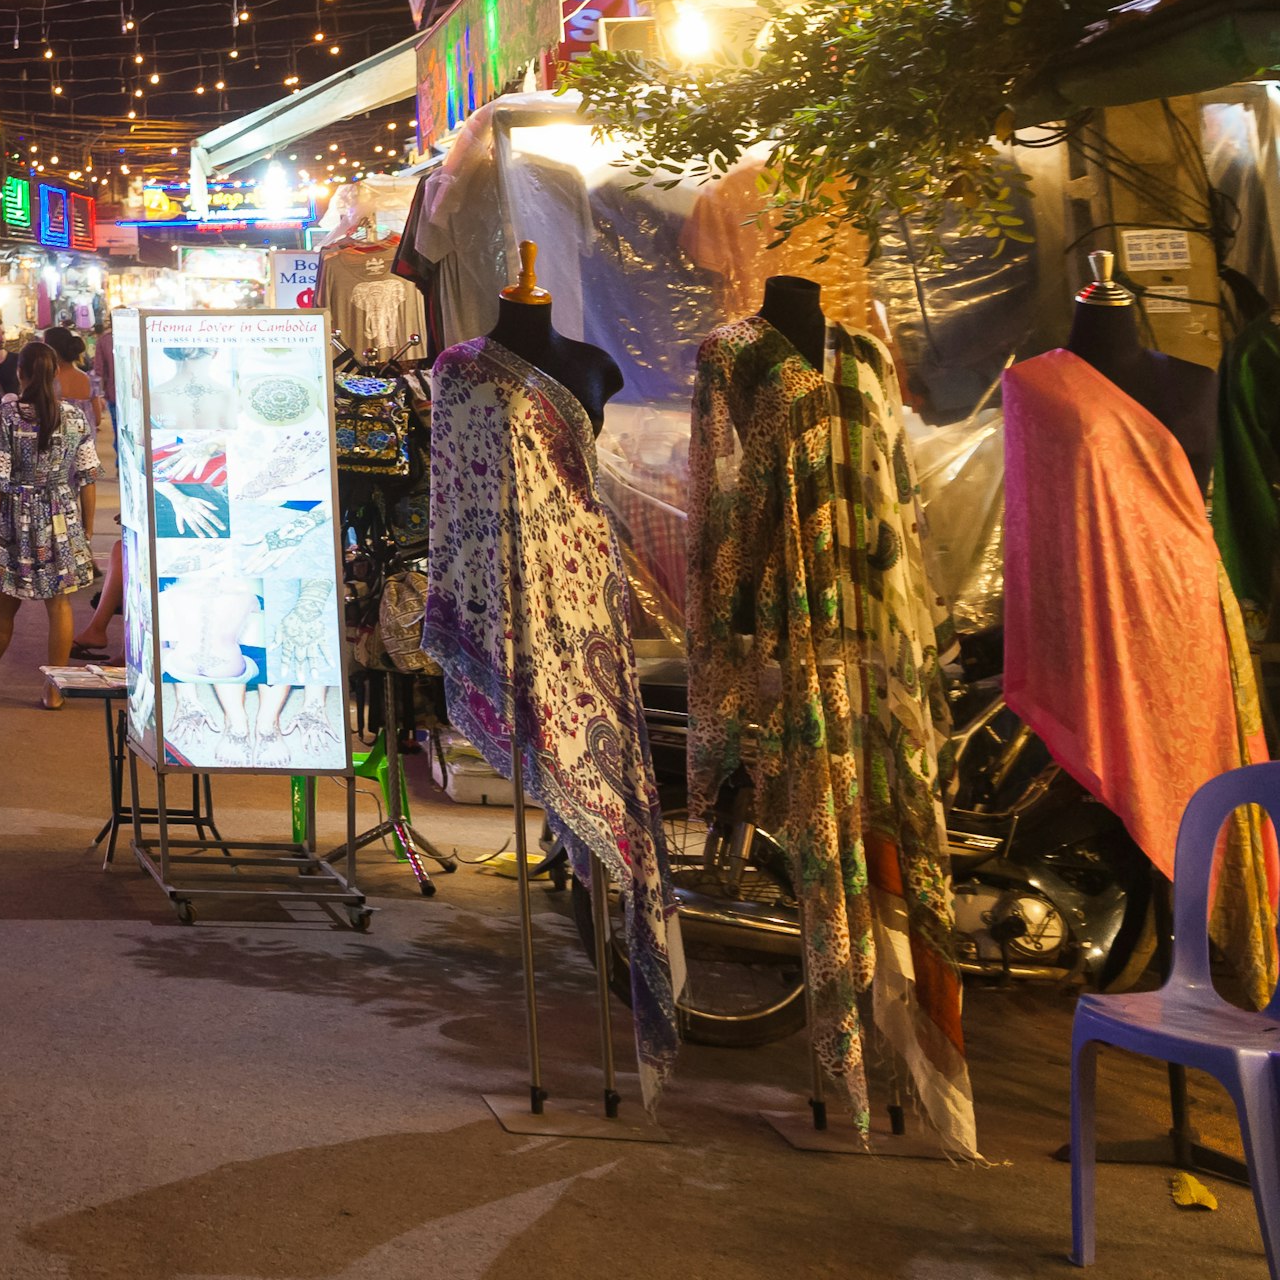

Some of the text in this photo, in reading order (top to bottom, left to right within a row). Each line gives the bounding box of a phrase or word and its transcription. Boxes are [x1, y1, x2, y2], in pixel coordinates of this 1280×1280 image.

[146, 319, 318, 333] Henna Lover in Cambodia
